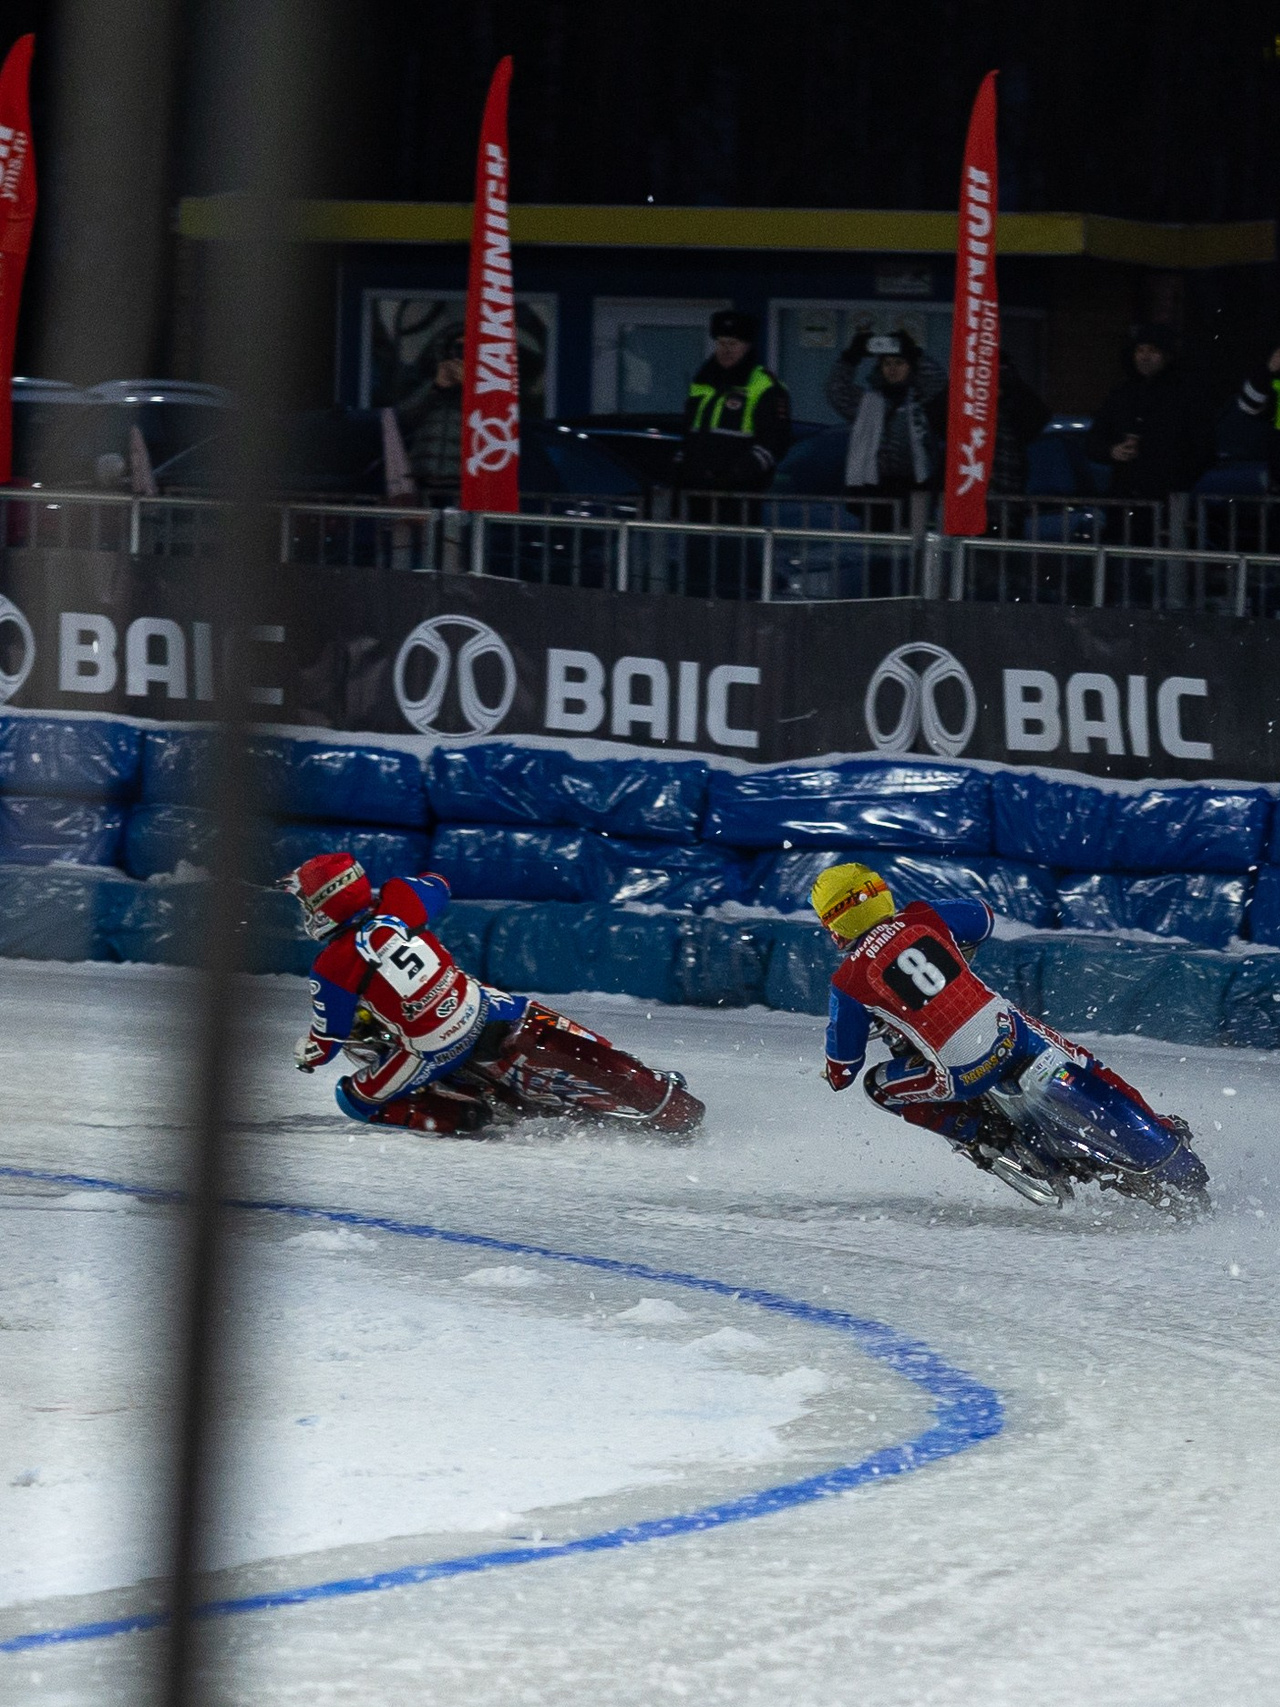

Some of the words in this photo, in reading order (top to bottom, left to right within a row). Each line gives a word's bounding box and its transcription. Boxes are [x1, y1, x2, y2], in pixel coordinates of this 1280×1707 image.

[970, 299, 998, 421] motorsport
[545, 648, 760, 748] BAIC
[1003, 668, 1215, 760] BAIC
[311, 871, 354, 907] SCOTT
[389, 943, 425, 980] 5
[865, 920, 905, 958] ОБЛАСТЬ
[896, 947, 946, 996] 8
[958, 1037, 1014, 1086] TARASOV
